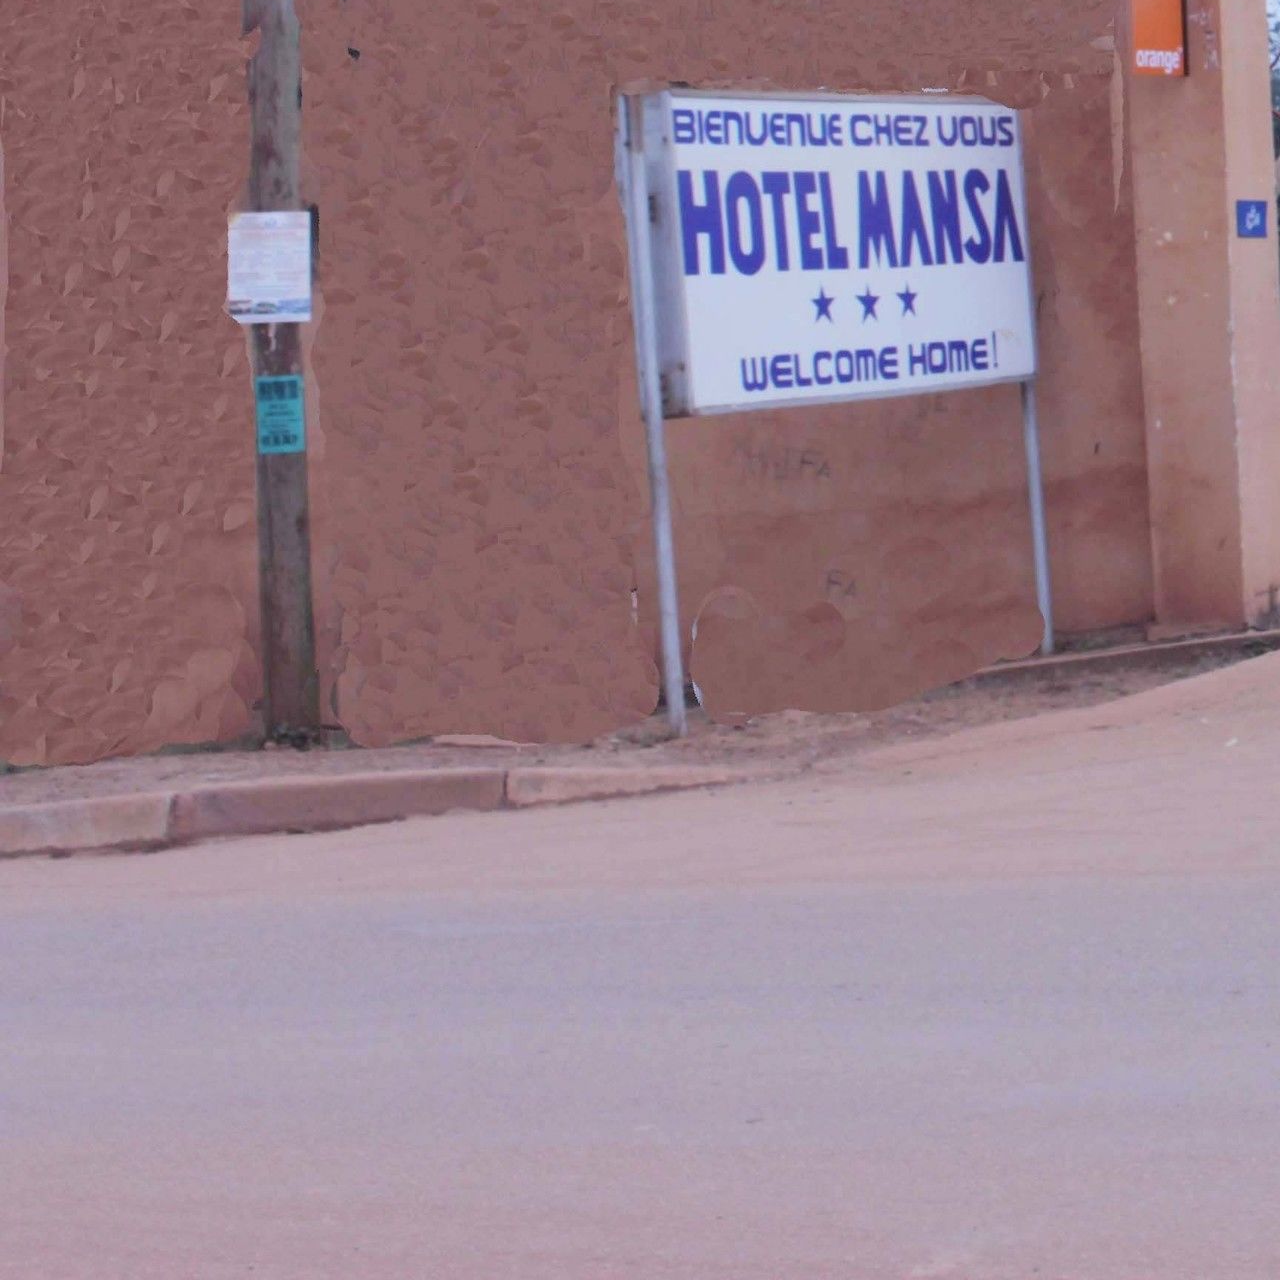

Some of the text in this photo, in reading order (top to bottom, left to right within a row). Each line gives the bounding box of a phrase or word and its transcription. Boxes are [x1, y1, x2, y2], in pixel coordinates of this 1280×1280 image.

[1136, 49, 1180, 74] orange
[672, 108, 1014, 147] BIENVENUE CHEZ VOUS
[676, 168, 1025, 276] HOTEL MANSA
[740, 330, 999, 392] WELCOME HOME!
